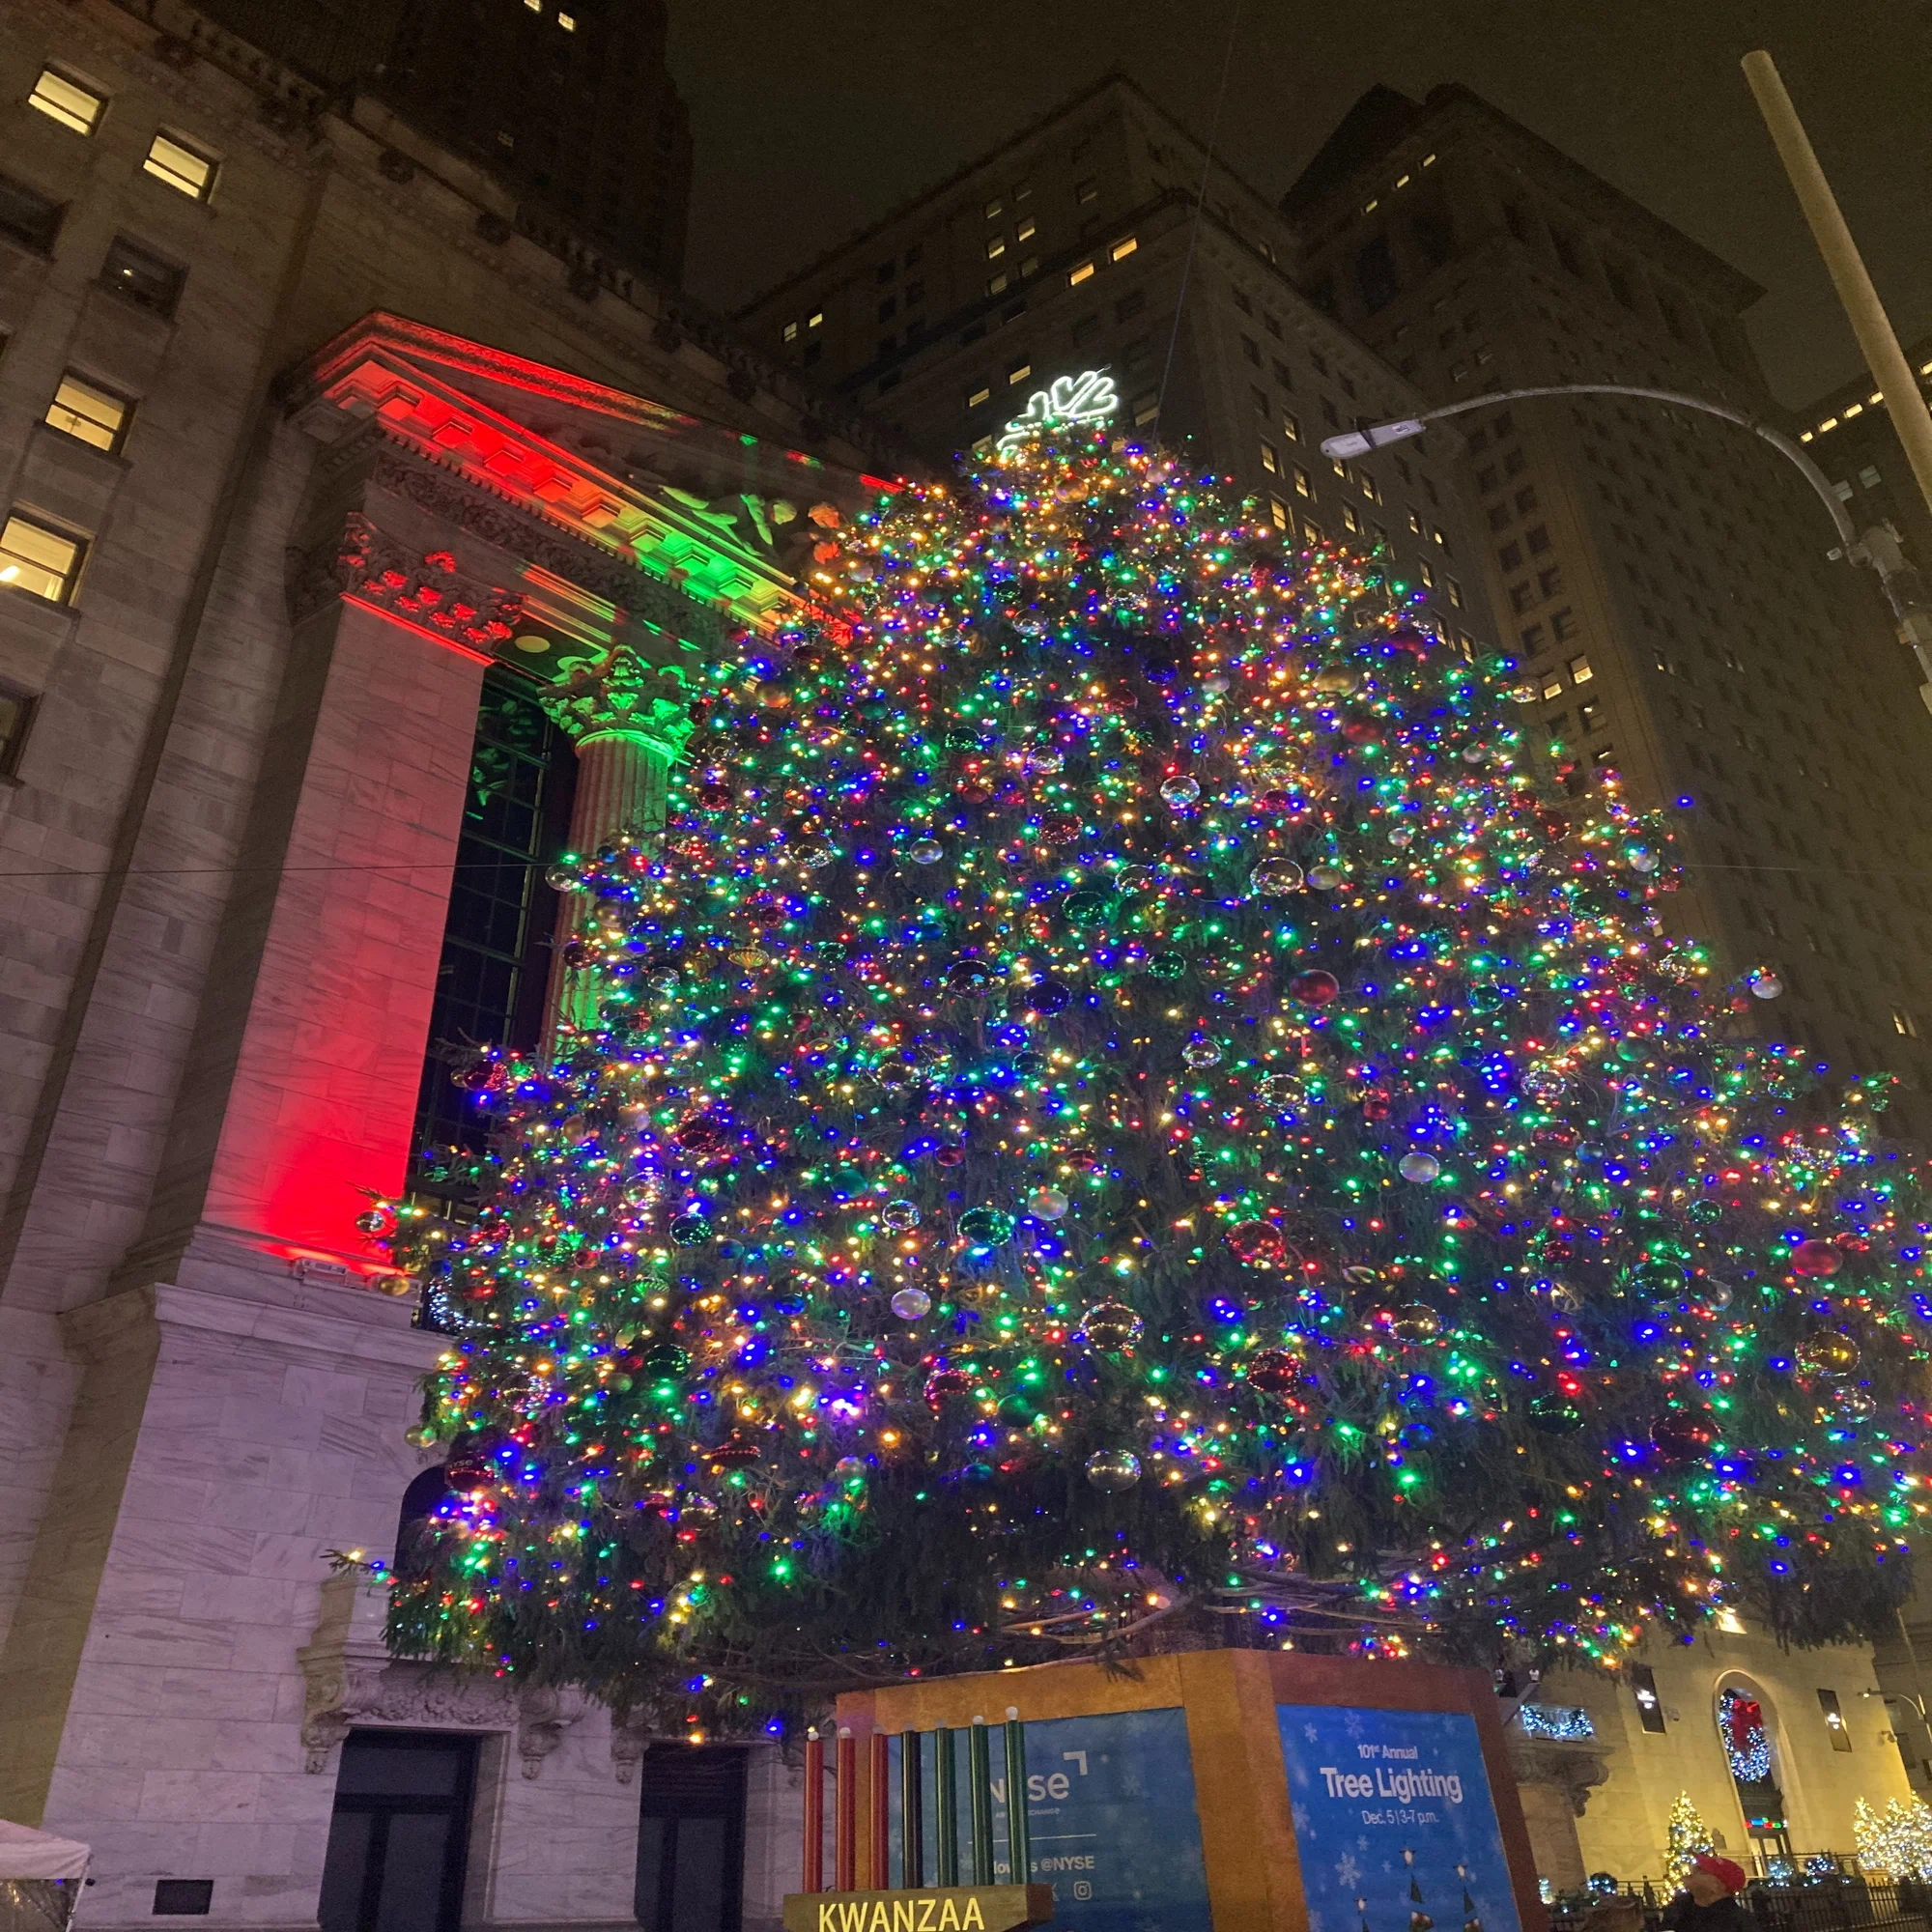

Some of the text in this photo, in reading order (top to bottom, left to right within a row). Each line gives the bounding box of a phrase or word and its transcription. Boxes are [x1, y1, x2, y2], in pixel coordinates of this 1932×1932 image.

[1382, 1745, 1418, 1759] Annual
[1320, 1767, 1463, 1804] Tree Lighting
[1361, 1809, 1386, 1825] Dec.
[1040, 1855, 1095, 1872] @NYSE
[818, 1896, 986, 1932] KWANZAA
